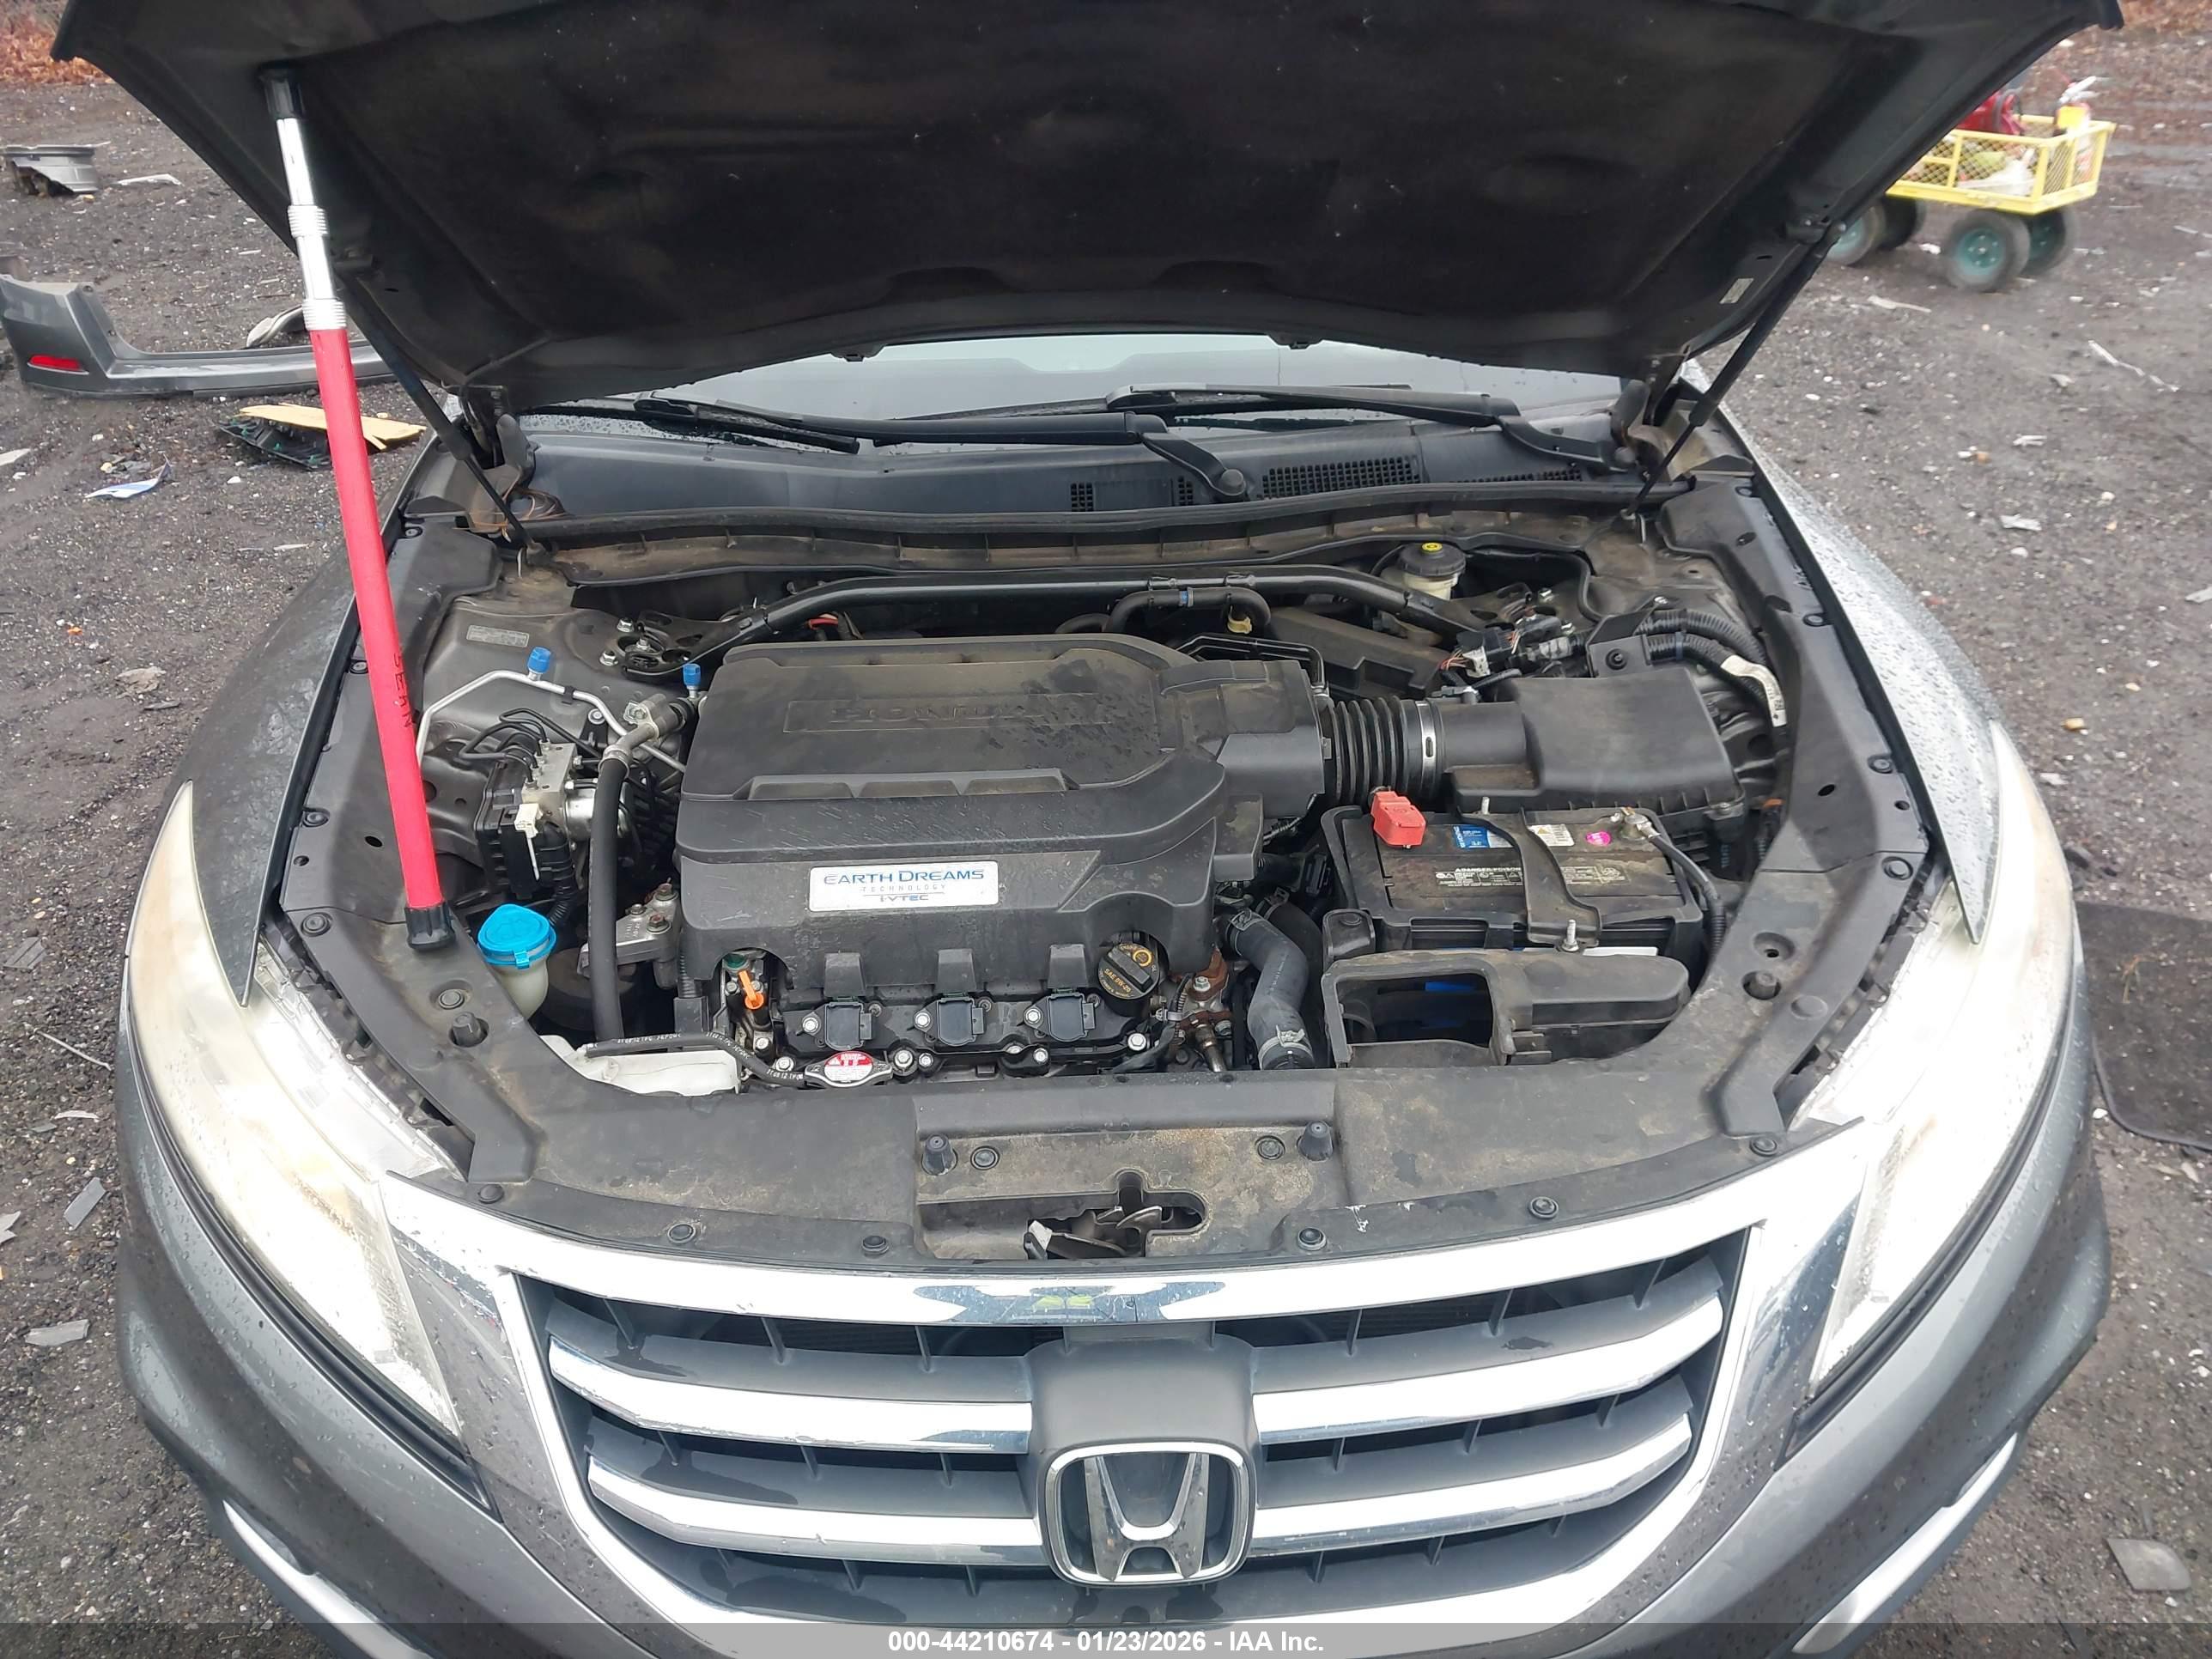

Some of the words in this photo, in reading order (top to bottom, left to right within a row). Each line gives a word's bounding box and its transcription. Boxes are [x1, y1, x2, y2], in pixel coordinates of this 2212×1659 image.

[823, 872, 893, 885] EARTH
[898, 870, 984, 883] DREAMS
[862, 883, 945, 893] TECHNOLOGY
[1104, 969, 1117, 981] SAE
